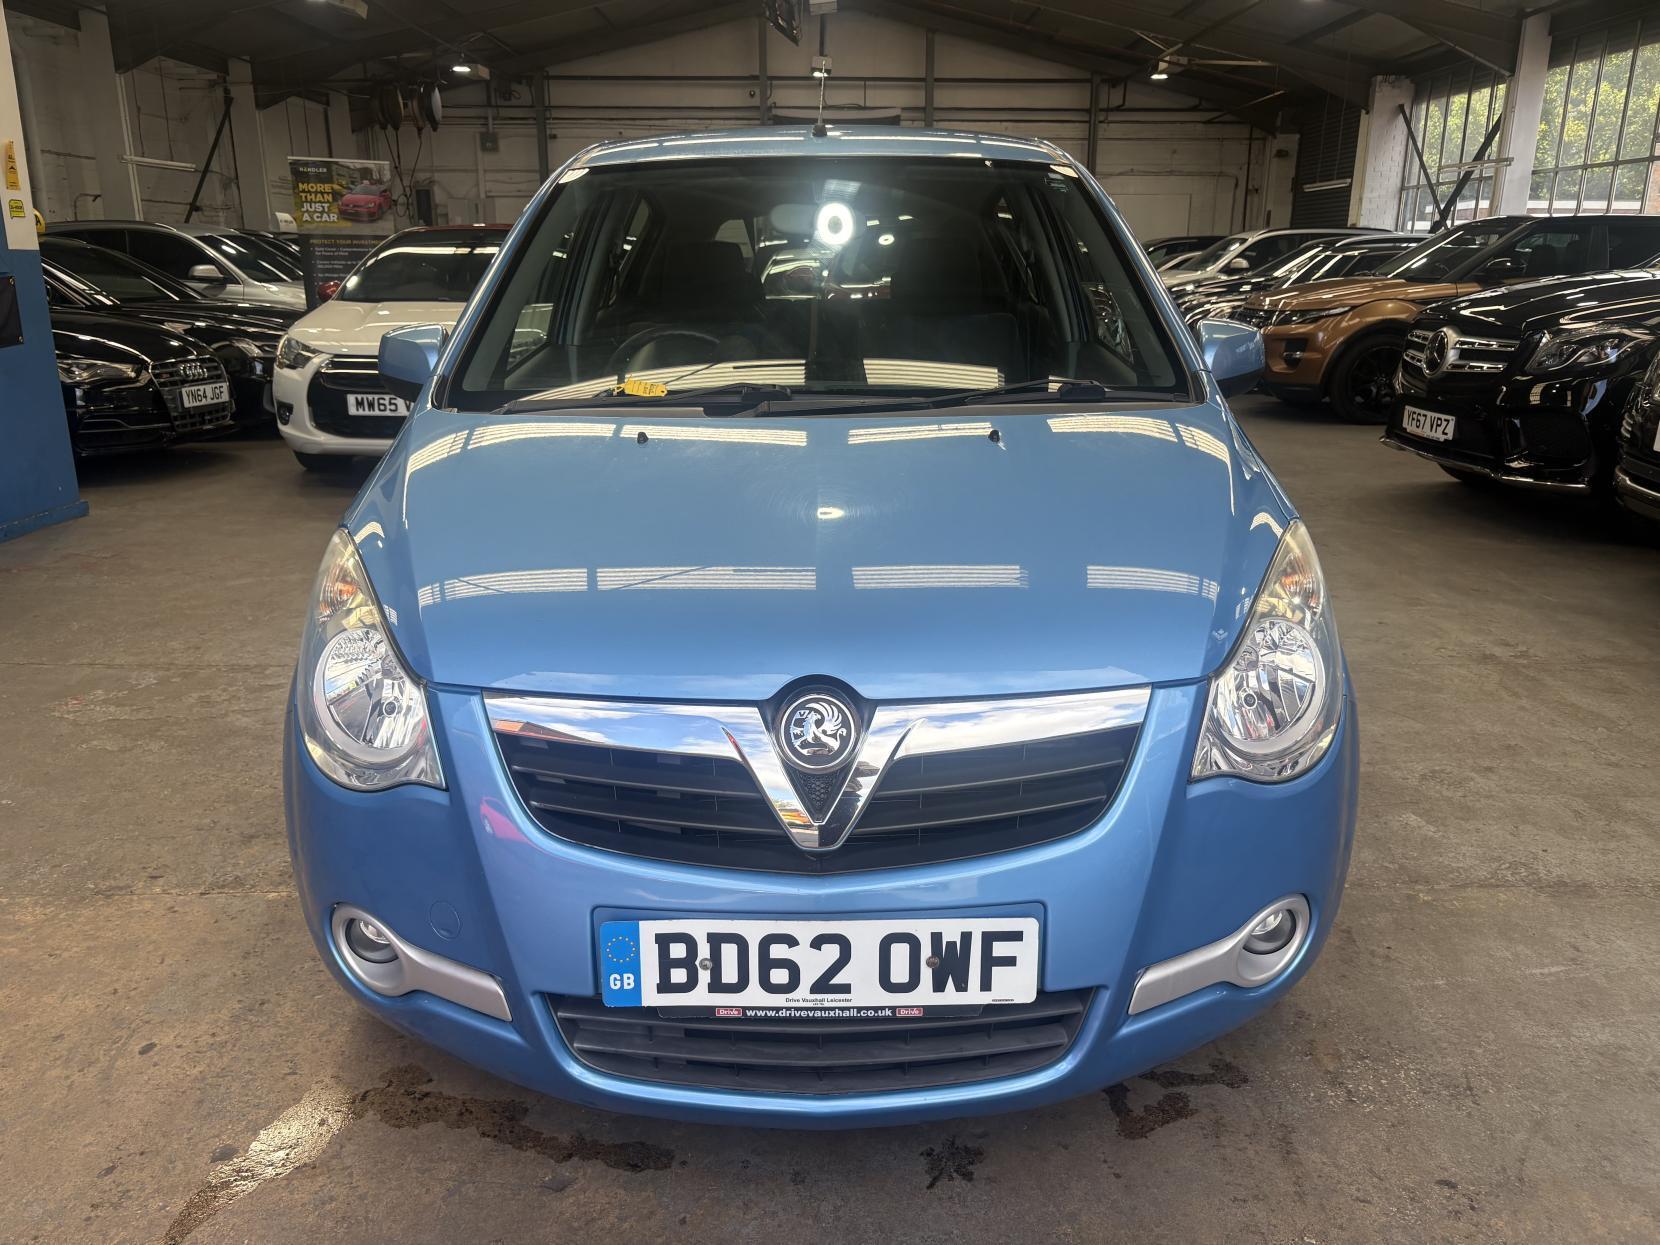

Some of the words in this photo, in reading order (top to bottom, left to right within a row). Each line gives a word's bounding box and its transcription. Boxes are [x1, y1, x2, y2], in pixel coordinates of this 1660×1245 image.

[298, 182, 333, 192] MORE
[299, 192, 333, 202] THAN
[301, 202, 330, 212] JUST
[302, 212, 311, 222] A
[312, 213, 338, 222] CAR
[185, 387, 208, 404] YN64
[210, 385, 224, 400] JGF
[355, 396, 398, 412] MW65
[1407, 409, 1428, 430] YF67
[1430, 415, 1450, 436] VPZ
[655, 932, 852, 995] BD62
[878, 930, 1024, 995] OWF
[609, 973, 635, 990] GB
[719, 1008, 739, 1016] Drive
[746, 1008, 893, 1017] www.drivevauxhall.co.uk
[900, 1008, 920, 1016] Drive
